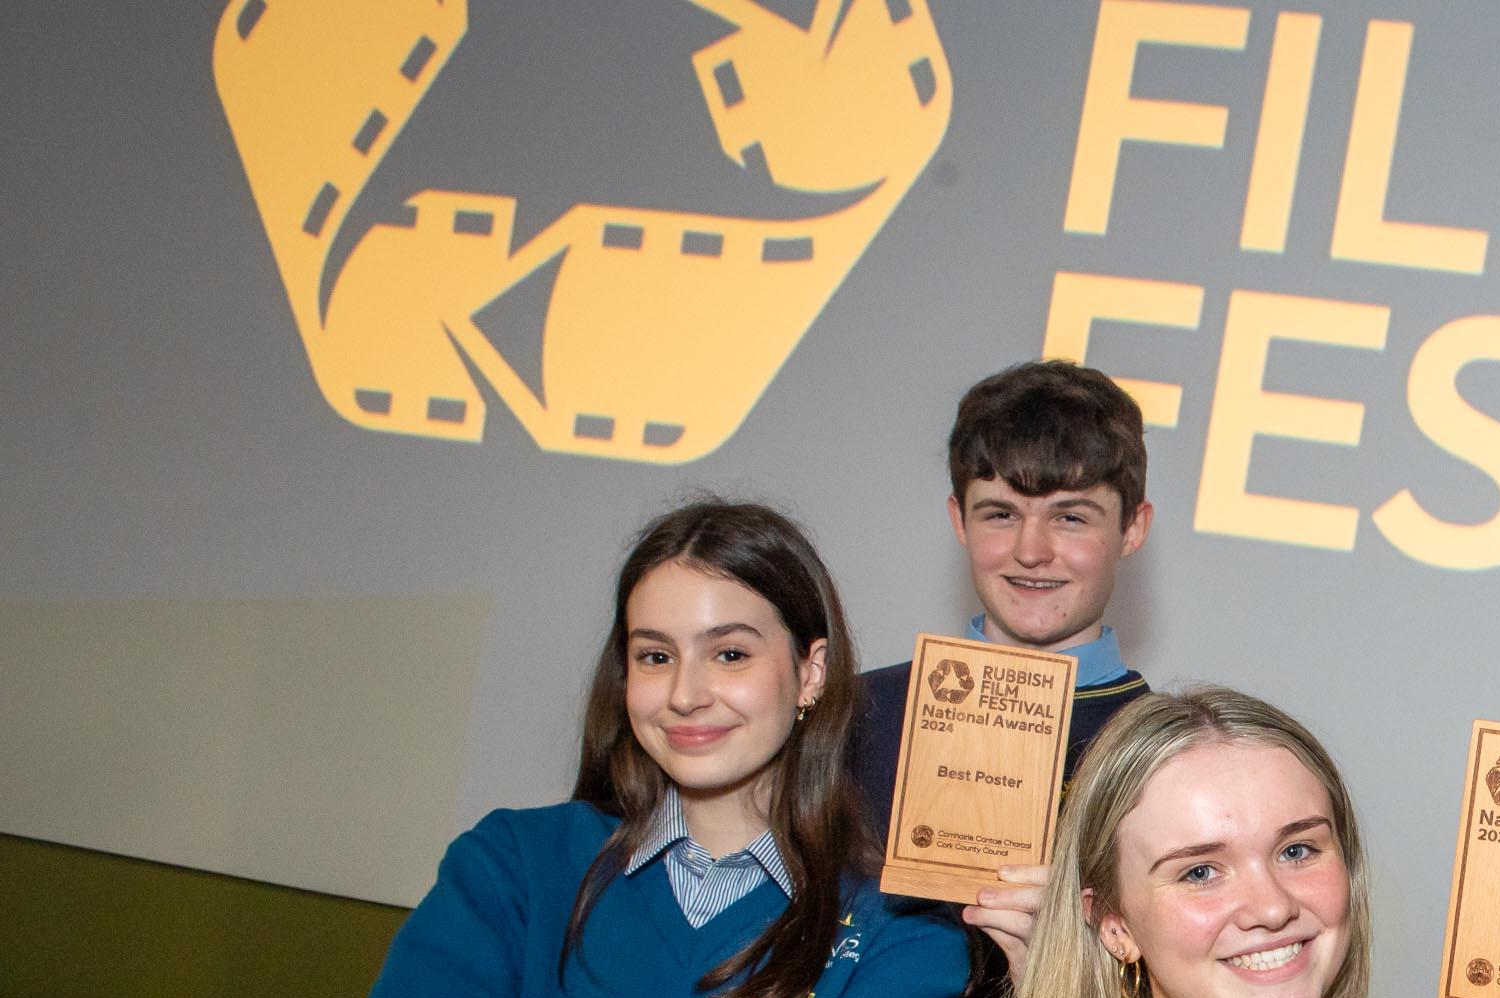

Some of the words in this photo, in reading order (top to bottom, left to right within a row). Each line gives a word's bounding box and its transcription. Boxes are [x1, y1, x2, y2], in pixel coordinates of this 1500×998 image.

[983, 665, 1053, 689] RUBBISH
[981, 680, 1019, 697] FILM
[979, 695, 1054, 719] FESTIVAL
[921, 719, 954, 733] 2024
[923, 704, 989, 726] National
[992, 715, 1053, 734] Awards
[938, 766, 971, 781] Best
[976, 771, 1023, 789] Poster
[955, 844, 981, 854] County
[982, 848, 1008, 856] Council
[976, 835, 1002, 845] Contae
